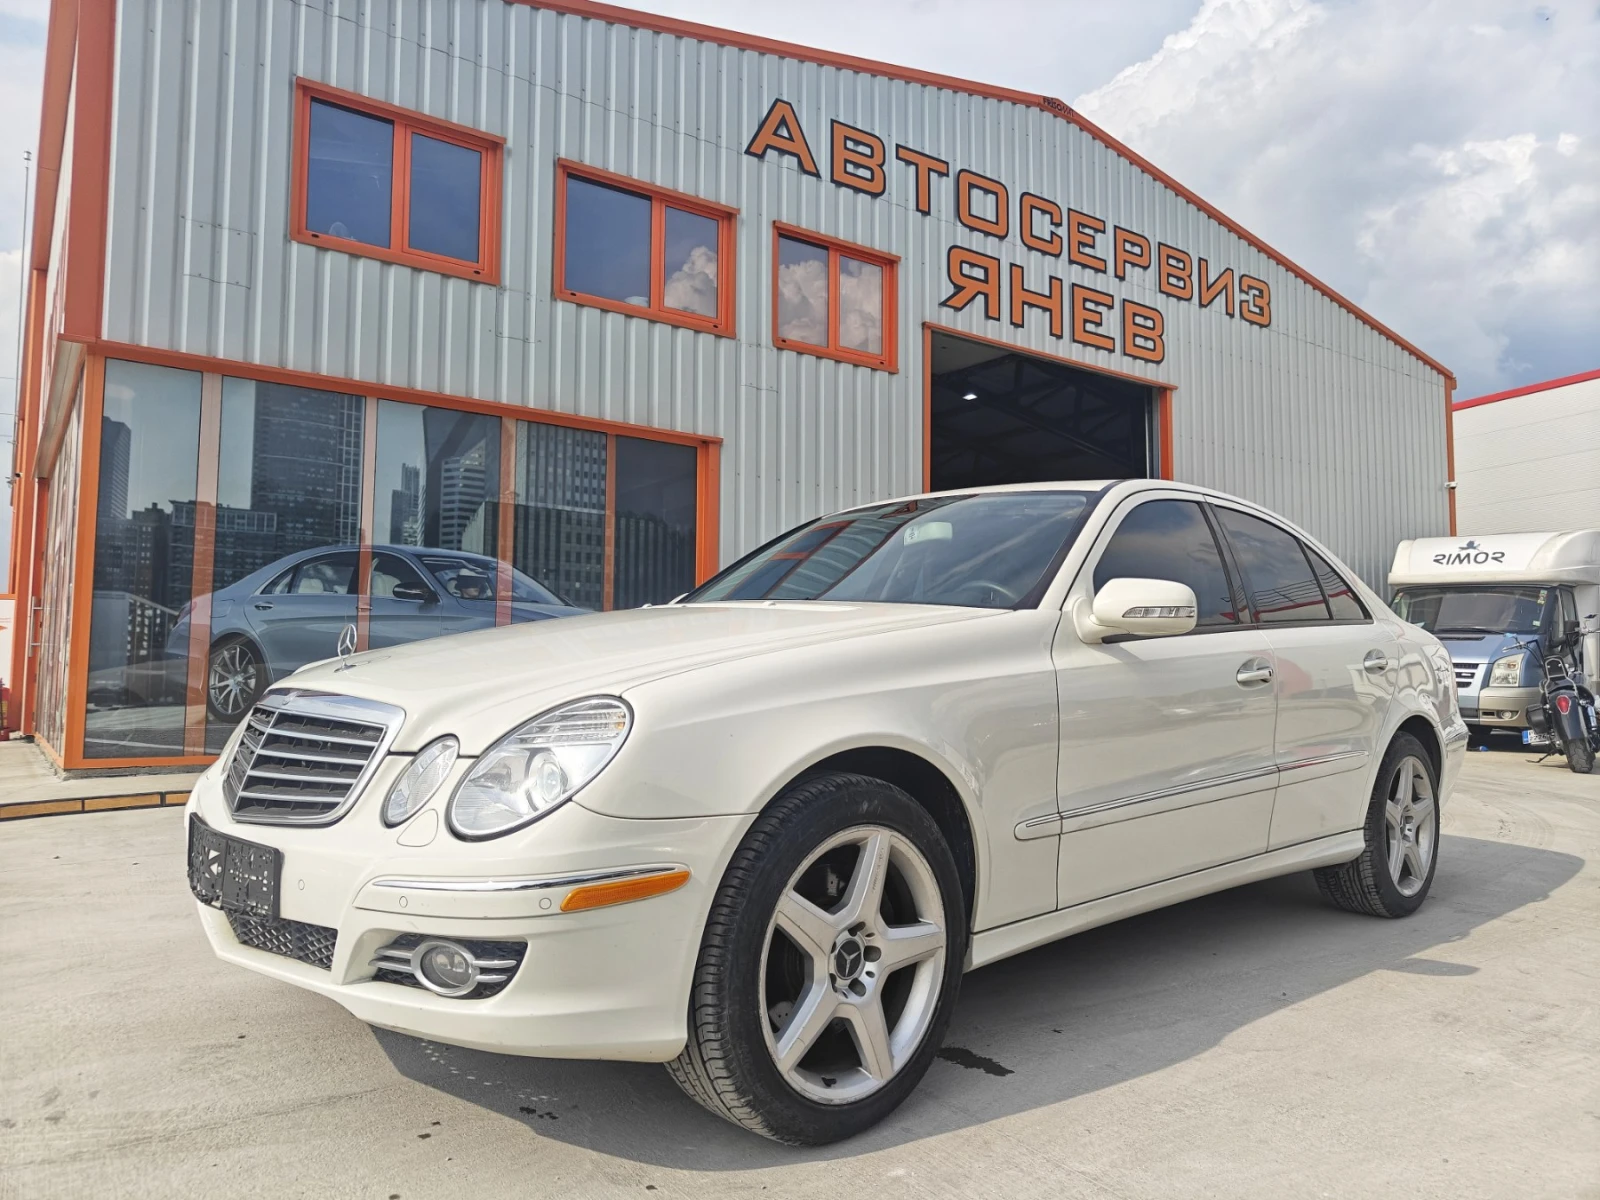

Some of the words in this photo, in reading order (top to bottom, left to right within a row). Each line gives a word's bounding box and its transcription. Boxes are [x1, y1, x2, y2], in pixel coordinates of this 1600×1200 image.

[745, 98, 1272, 327] АВТОСЕРВИЗ
[940, 245, 1165, 363] ЯНЕВ
[1433, 551, 1505, 565] RIMOR
